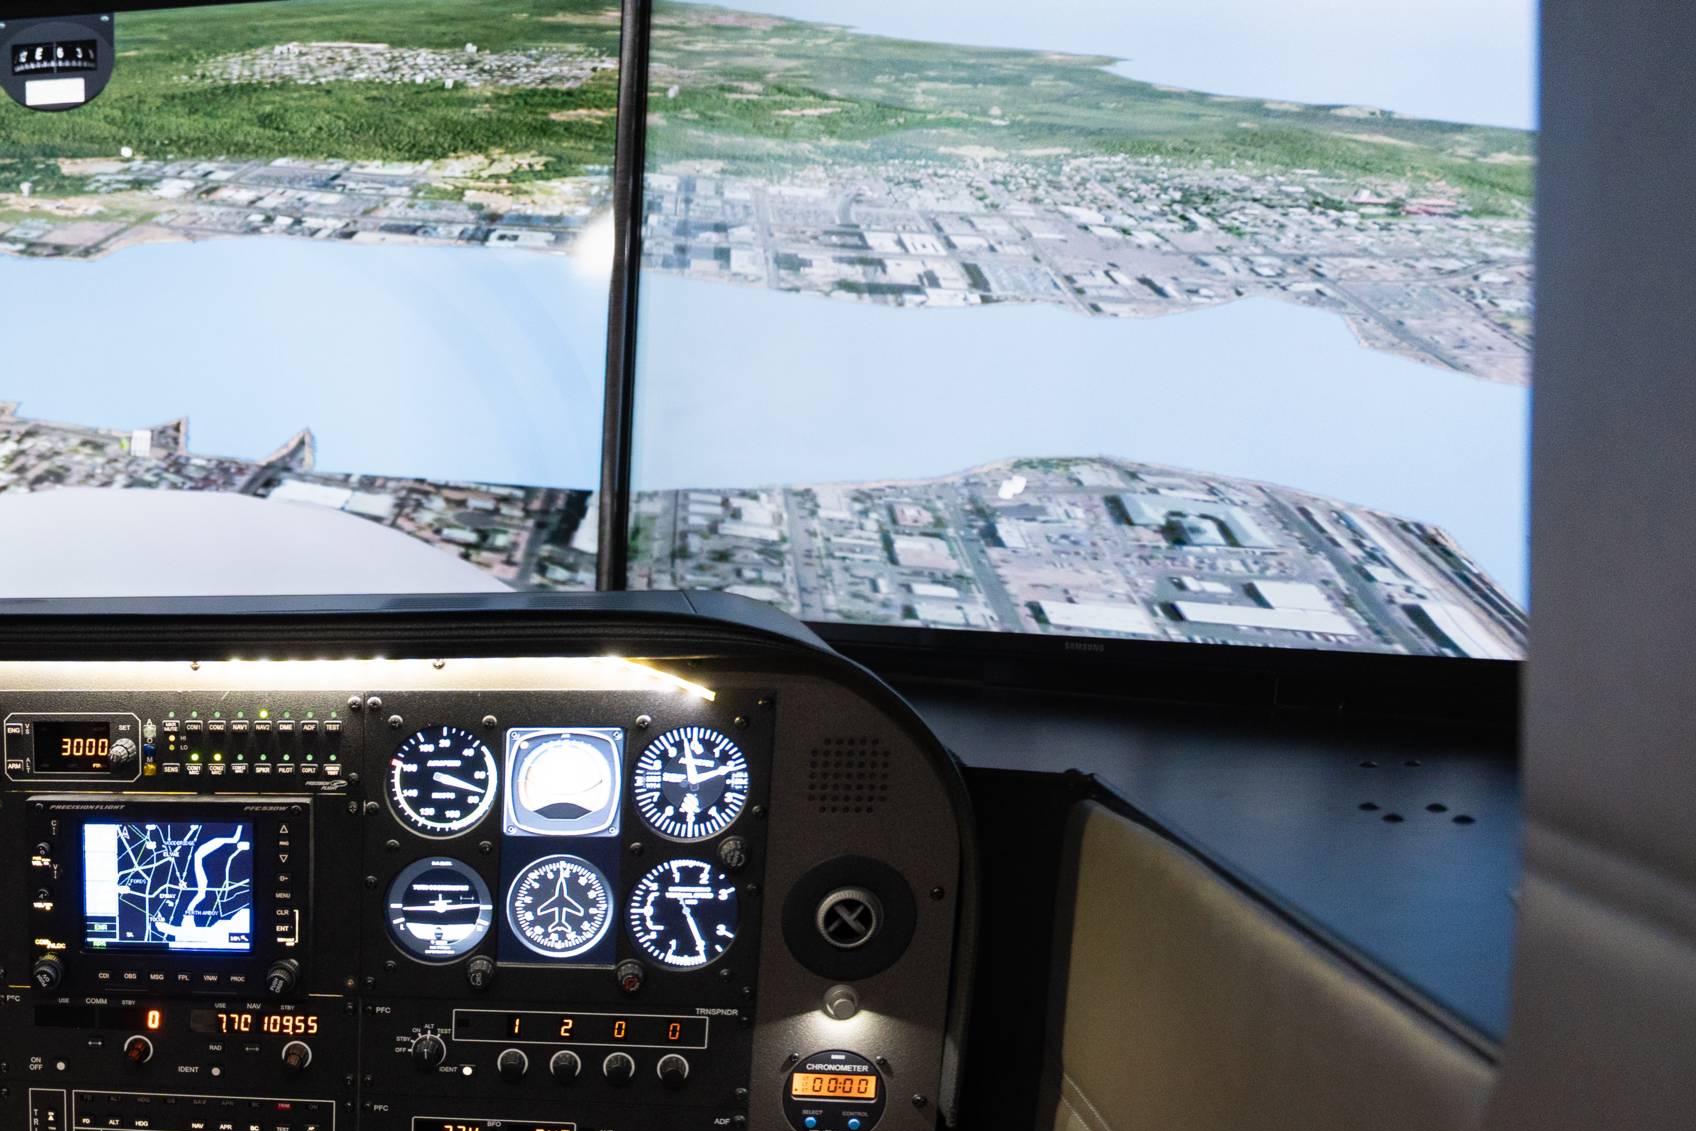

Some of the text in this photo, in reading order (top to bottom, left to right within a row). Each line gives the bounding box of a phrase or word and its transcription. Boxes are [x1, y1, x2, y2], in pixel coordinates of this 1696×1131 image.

[61, 738, 109, 756] 3000
[49, 803, 126, 811] PRECISION FLIGHT
[123, 972, 137, 980] OBS
[85, 997, 107, 1005] COMM
[246, 1002, 261, 1010] NAV
[375, 1006, 391, 1014] PFC
[695, 1008, 738, 1017] TRNSPNDR
[30, 1056, 42, 1064] ON
[29, 1063, 44, 1071] OFF
[177, 1065, 200, 1074] IDENT
[806, 1063, 869, 1072] CHRONOMETER
[812, 1077, 869, 1094] 00:00
[373, 1104, 389, 1112] PFC
[714, 1117, 731, 1125] ADF
[191, 1122, 205, 1130] NAV
[218, 1123, 233, 1131] APR
